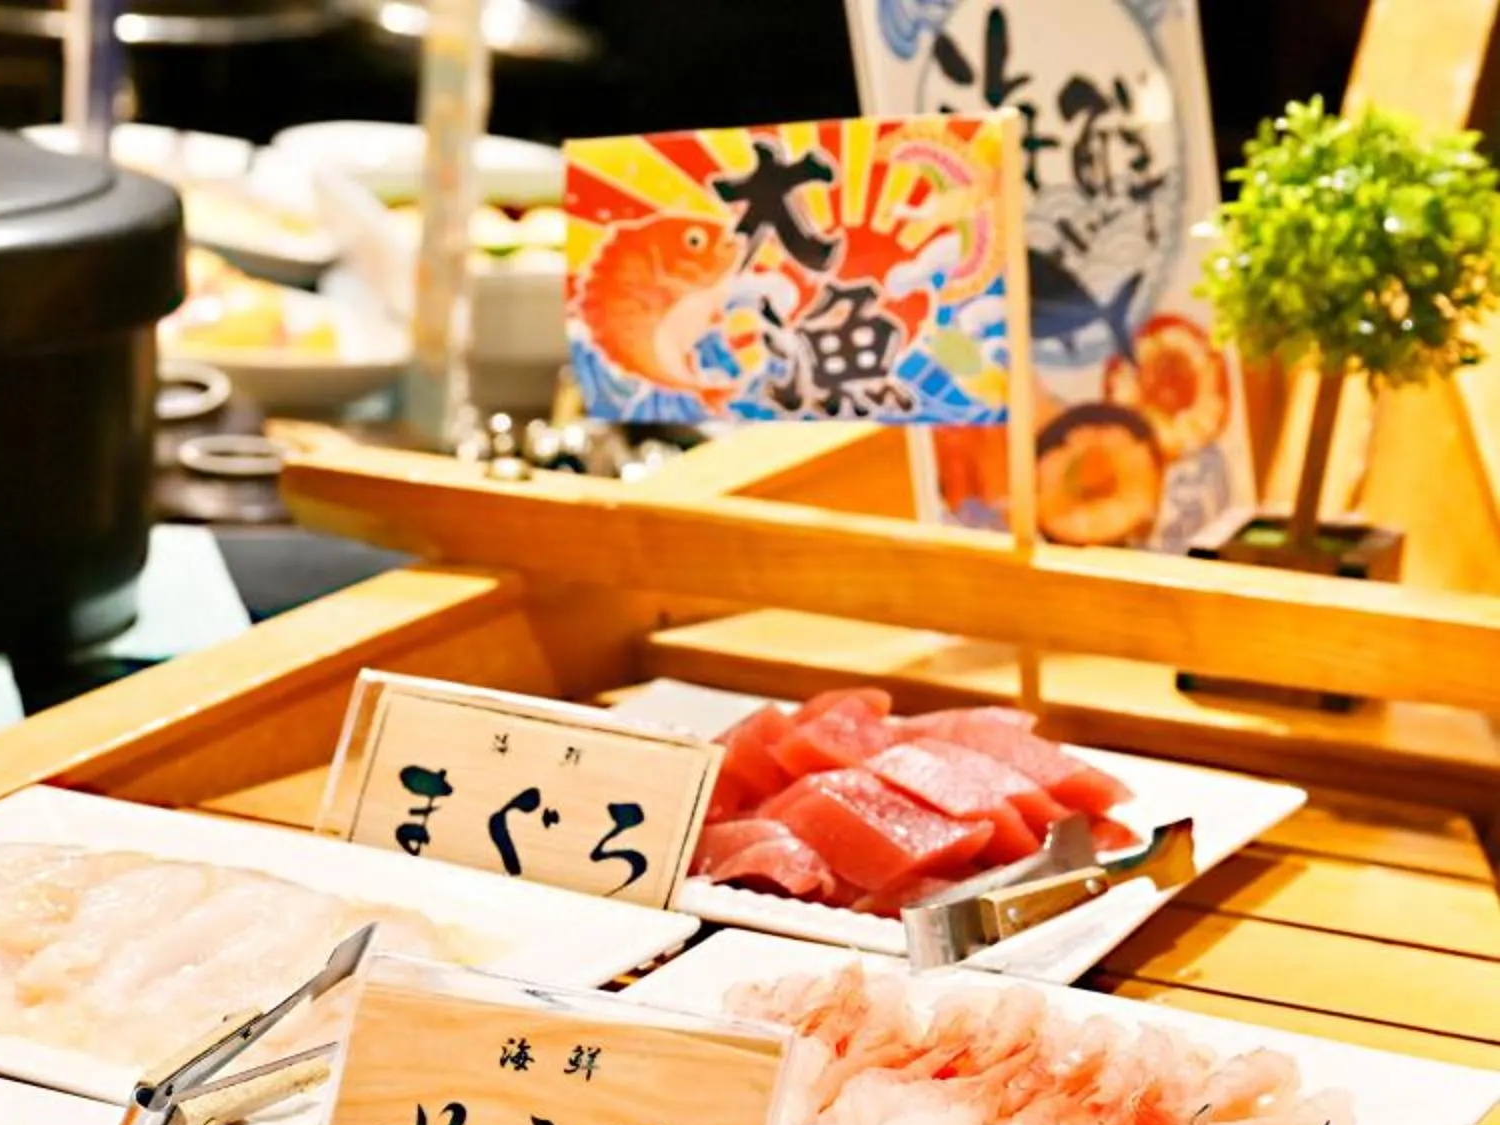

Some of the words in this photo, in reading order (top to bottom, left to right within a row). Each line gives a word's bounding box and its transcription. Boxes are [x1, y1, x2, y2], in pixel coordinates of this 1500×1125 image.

[711, 140, 913, 418] 大漁
[395, 764, 649, 899] まぐろ
[499, 1037, 602, 1081] 海鮮
